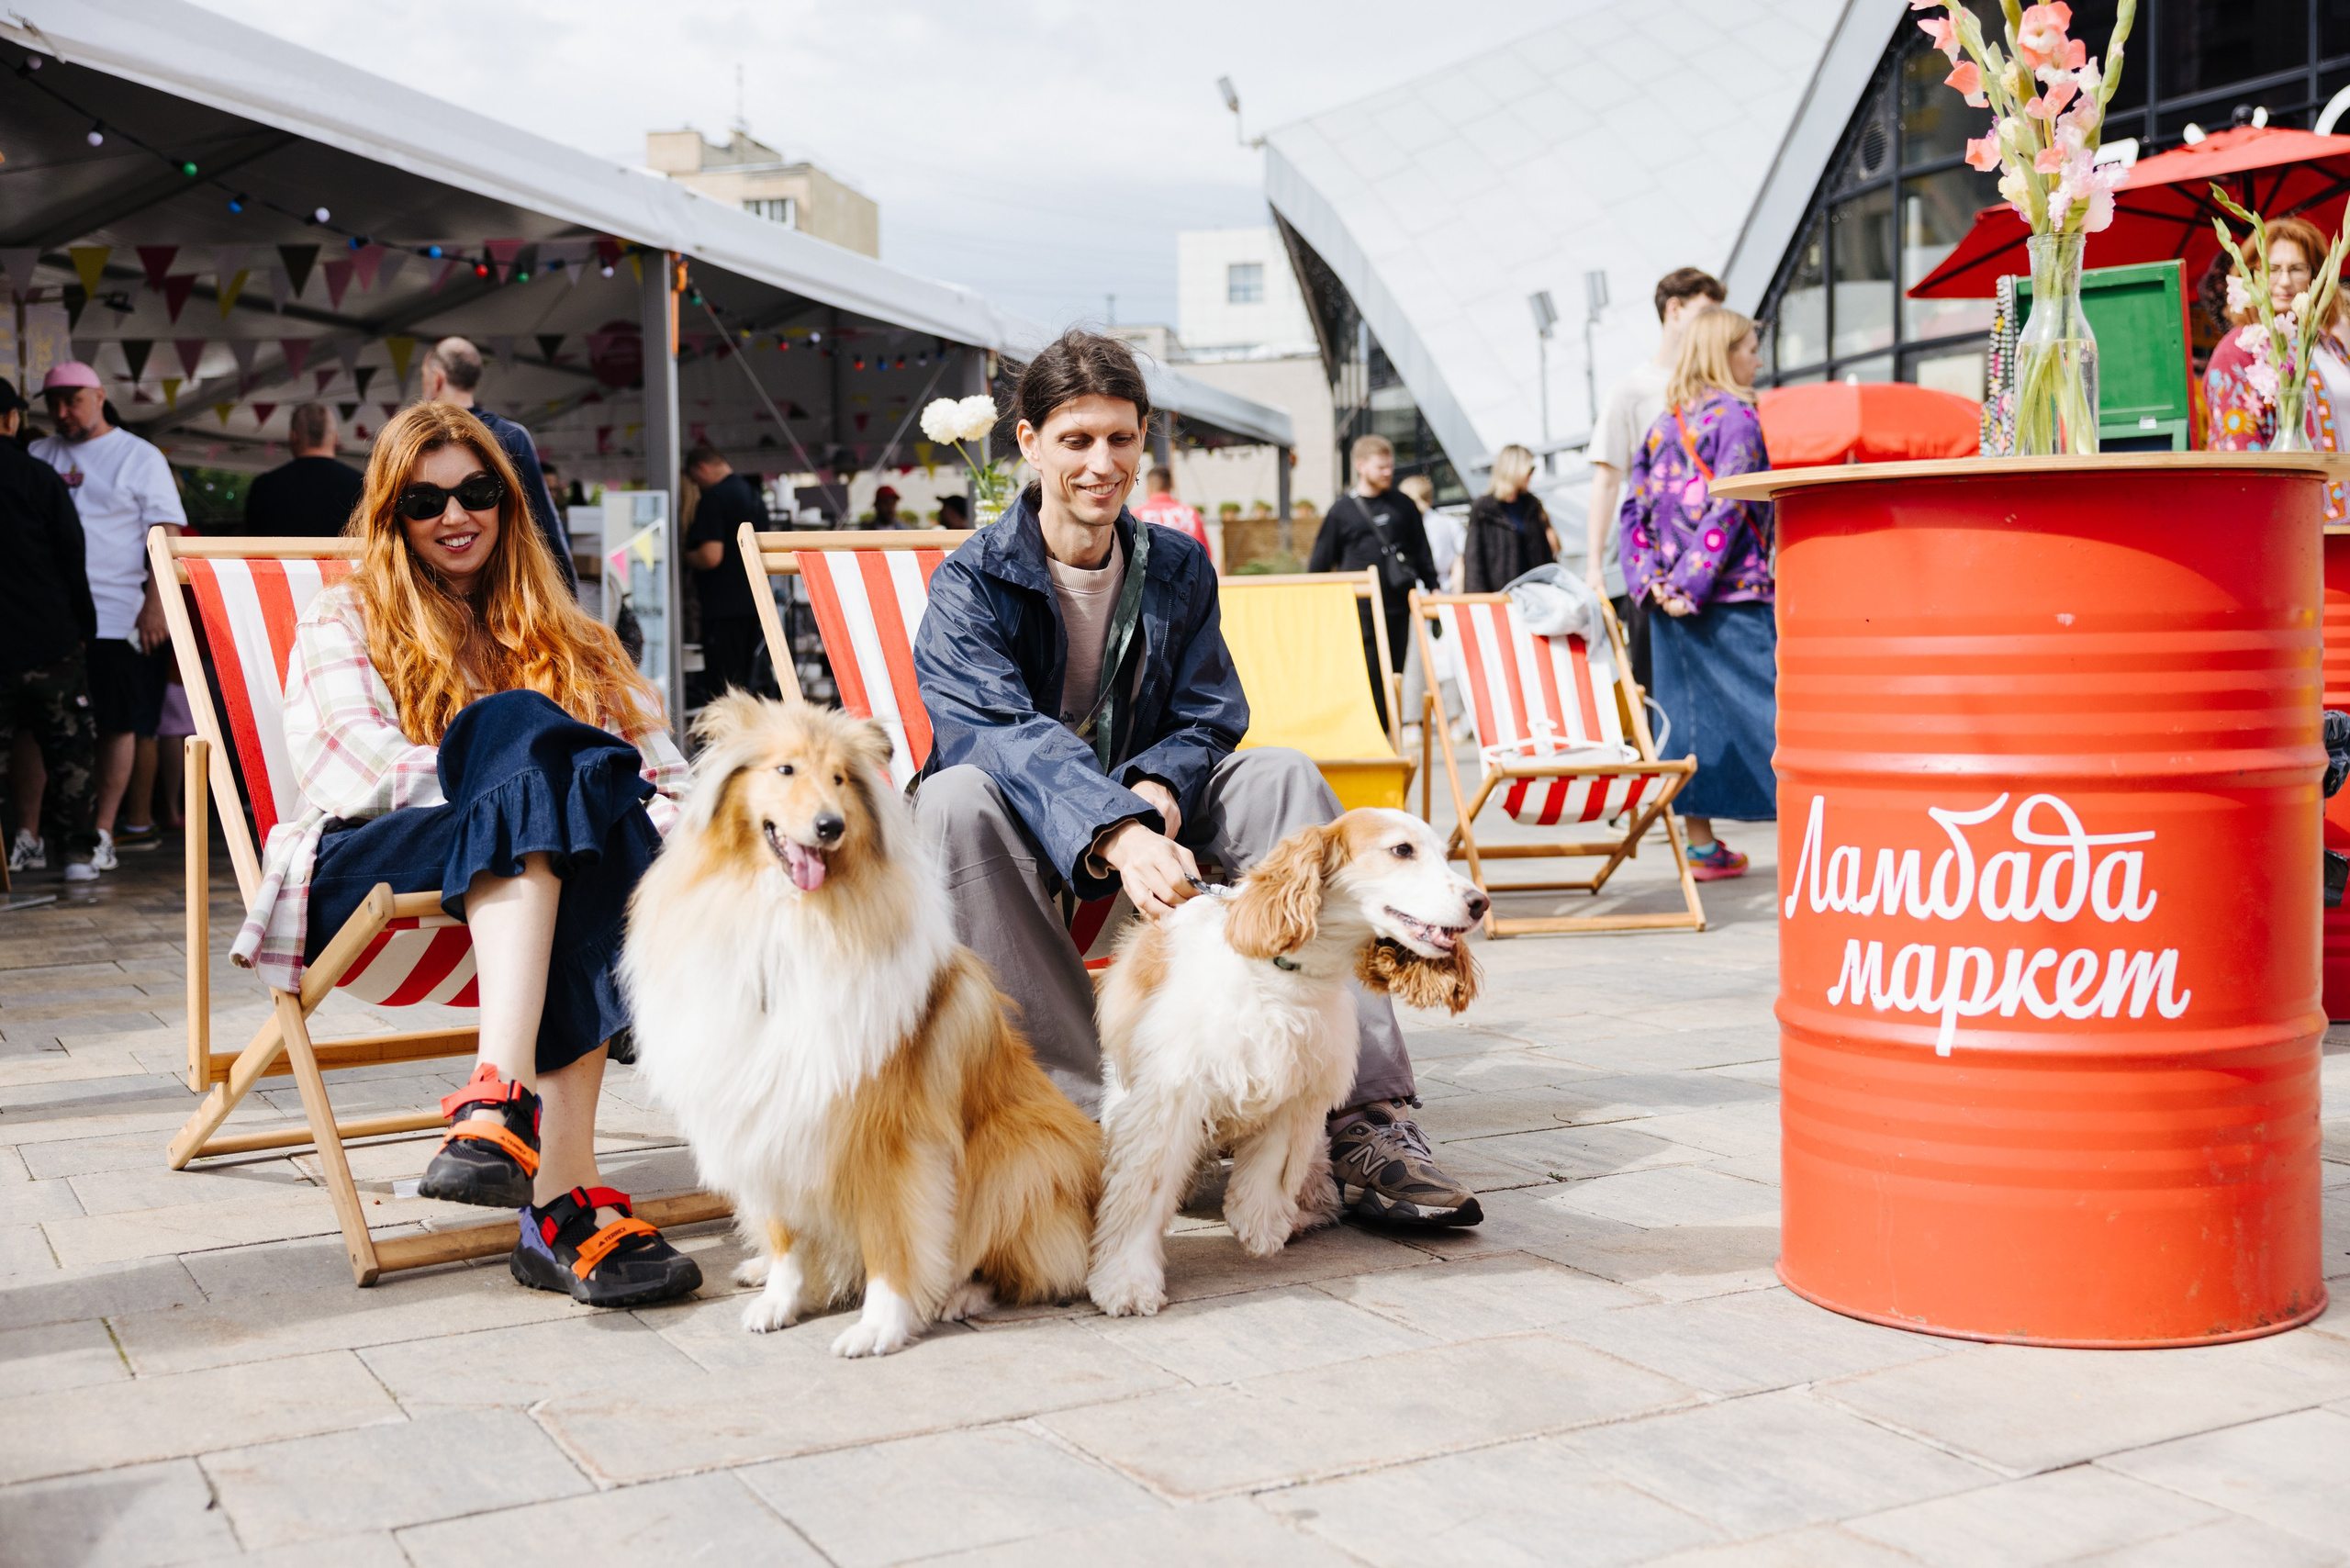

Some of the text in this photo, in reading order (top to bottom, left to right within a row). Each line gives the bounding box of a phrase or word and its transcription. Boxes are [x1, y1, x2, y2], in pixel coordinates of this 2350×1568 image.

[1785, 793, 2156, 923] Ламбада
[1828, 939, 2190, 1057] маркет
[507, 1139, 527, 1155] TERREX
[1348, 1143, 1389, 1178] N
[604, 1226, 627, 1241] TERREX
